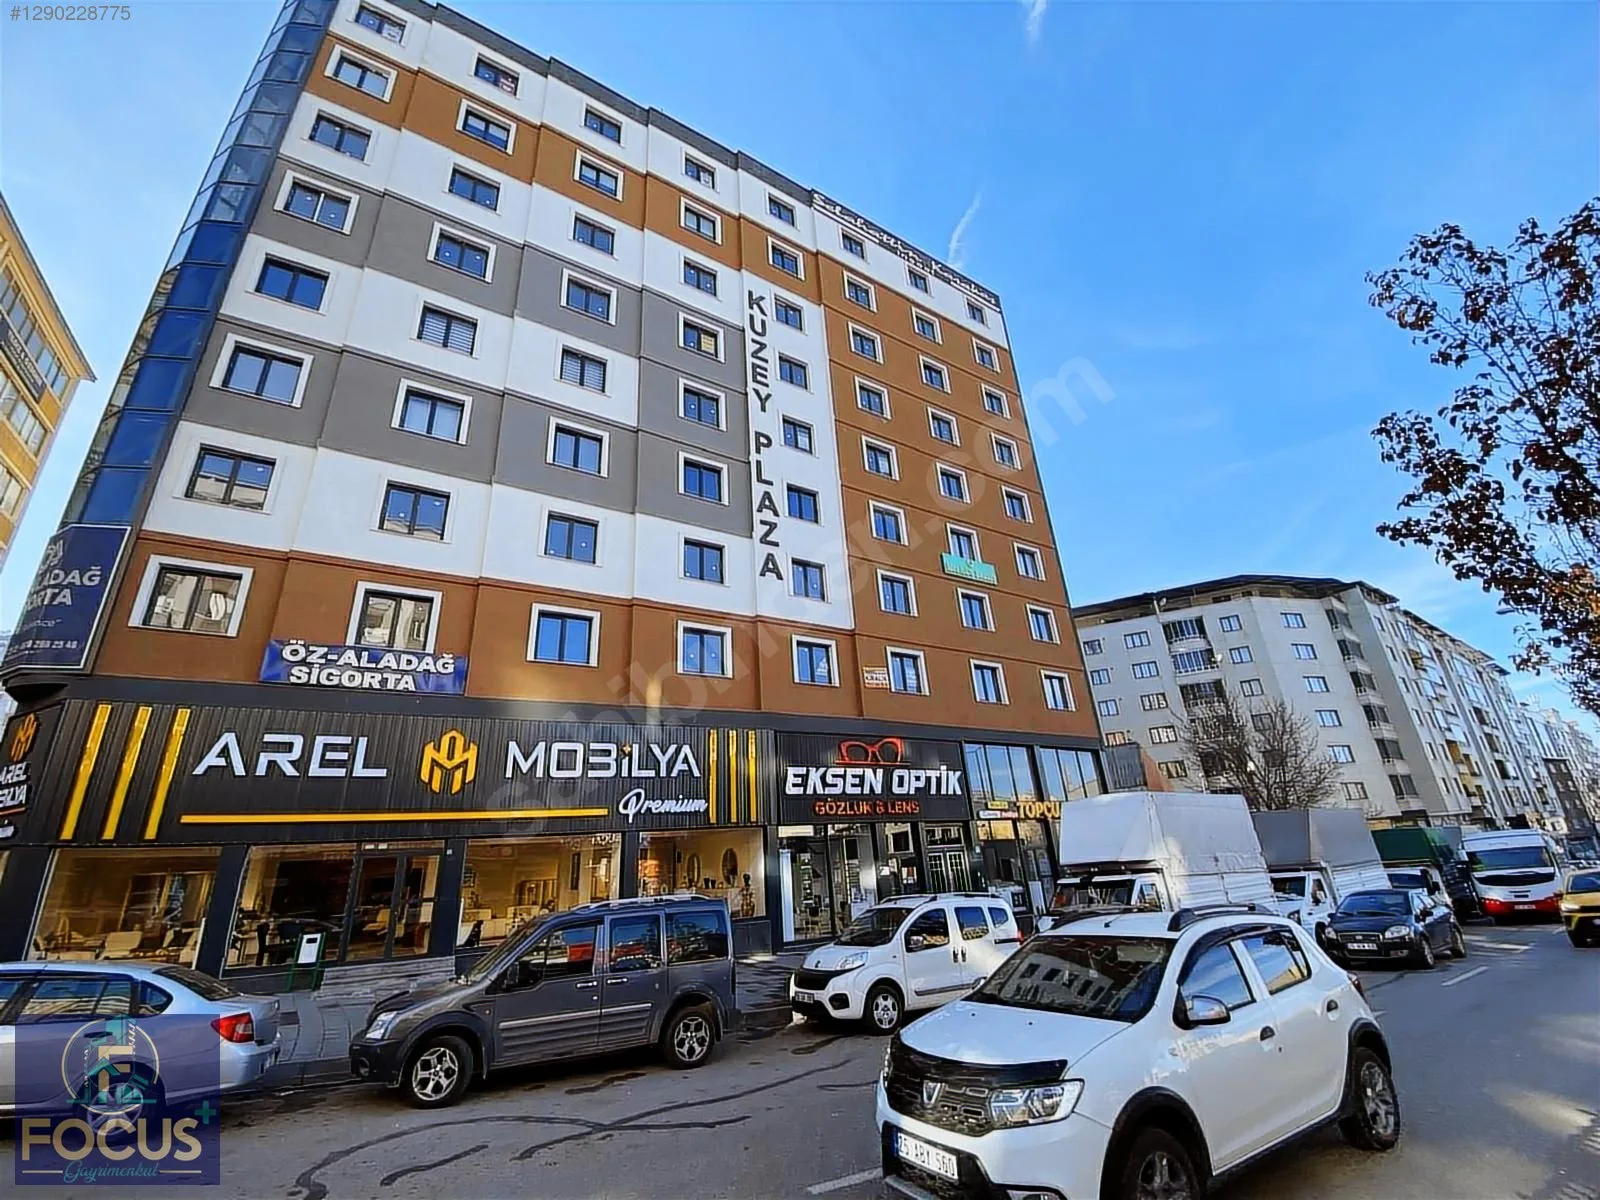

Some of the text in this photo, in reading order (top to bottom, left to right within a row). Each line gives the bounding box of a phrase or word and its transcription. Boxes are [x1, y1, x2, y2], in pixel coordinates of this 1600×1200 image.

[748, 289, 784, 581] KUZEY PLAZA
[282, 640, 455, 673] ÖZ-ALADAĞ
[289, 663, 416, 692] SİGORTA
[192, 731, 388, 778] AREL
[785, 765, 963, 796] EKSEN OPTİK
[618, 788, 708, 824] Premium
[888, 801, 920, 814] LENS
